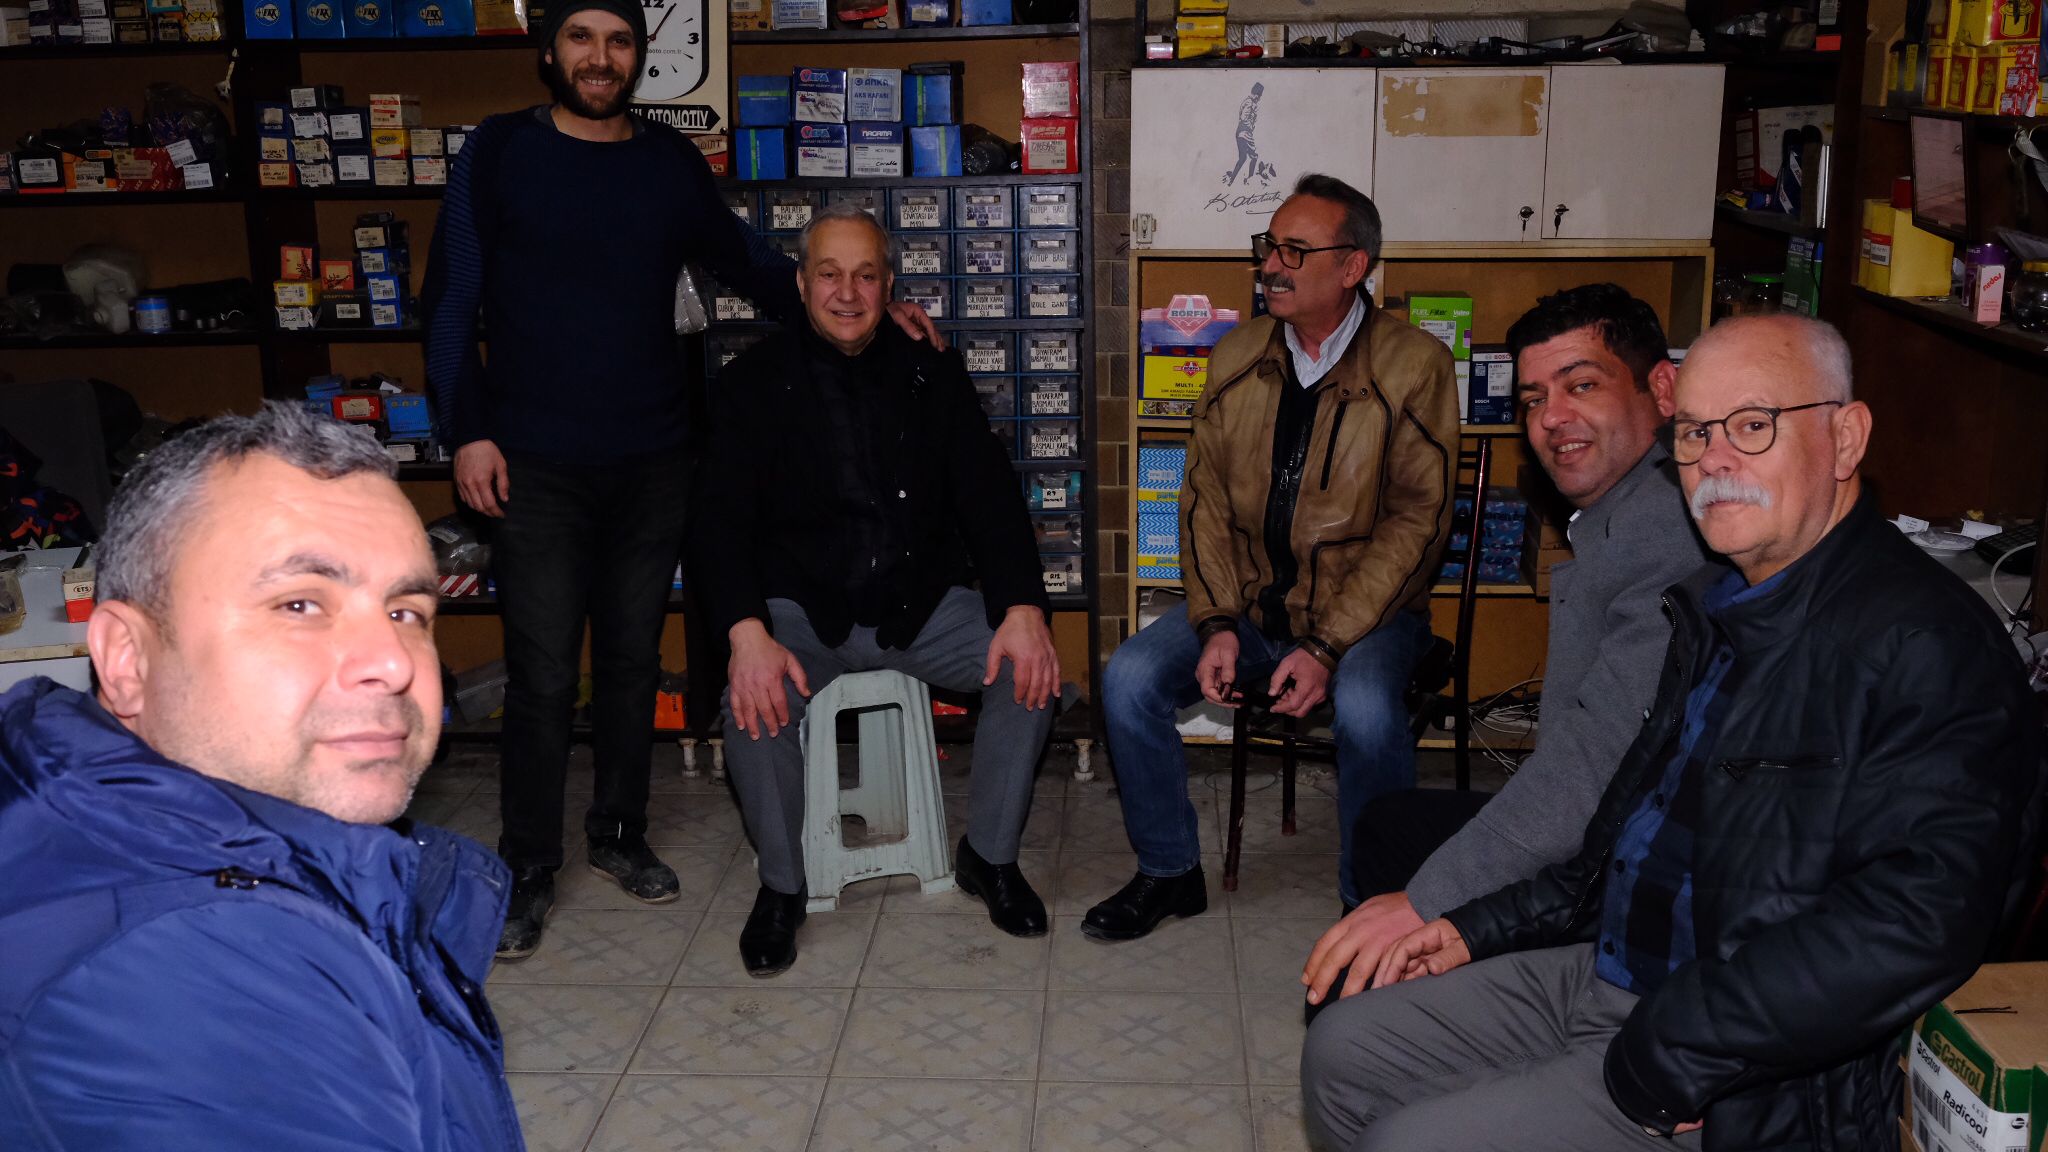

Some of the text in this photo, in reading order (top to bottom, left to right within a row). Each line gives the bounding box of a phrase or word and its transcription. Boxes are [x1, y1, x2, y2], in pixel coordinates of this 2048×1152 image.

[687, 32, 700, 45] 3
[648, 65, 660, 78] 6
[1920, 1048, 1941, 1077] Castrol
[1941, 1043, 1981, 1092] Castrol
[1943, 1090, 1988, 1138] Radicool
